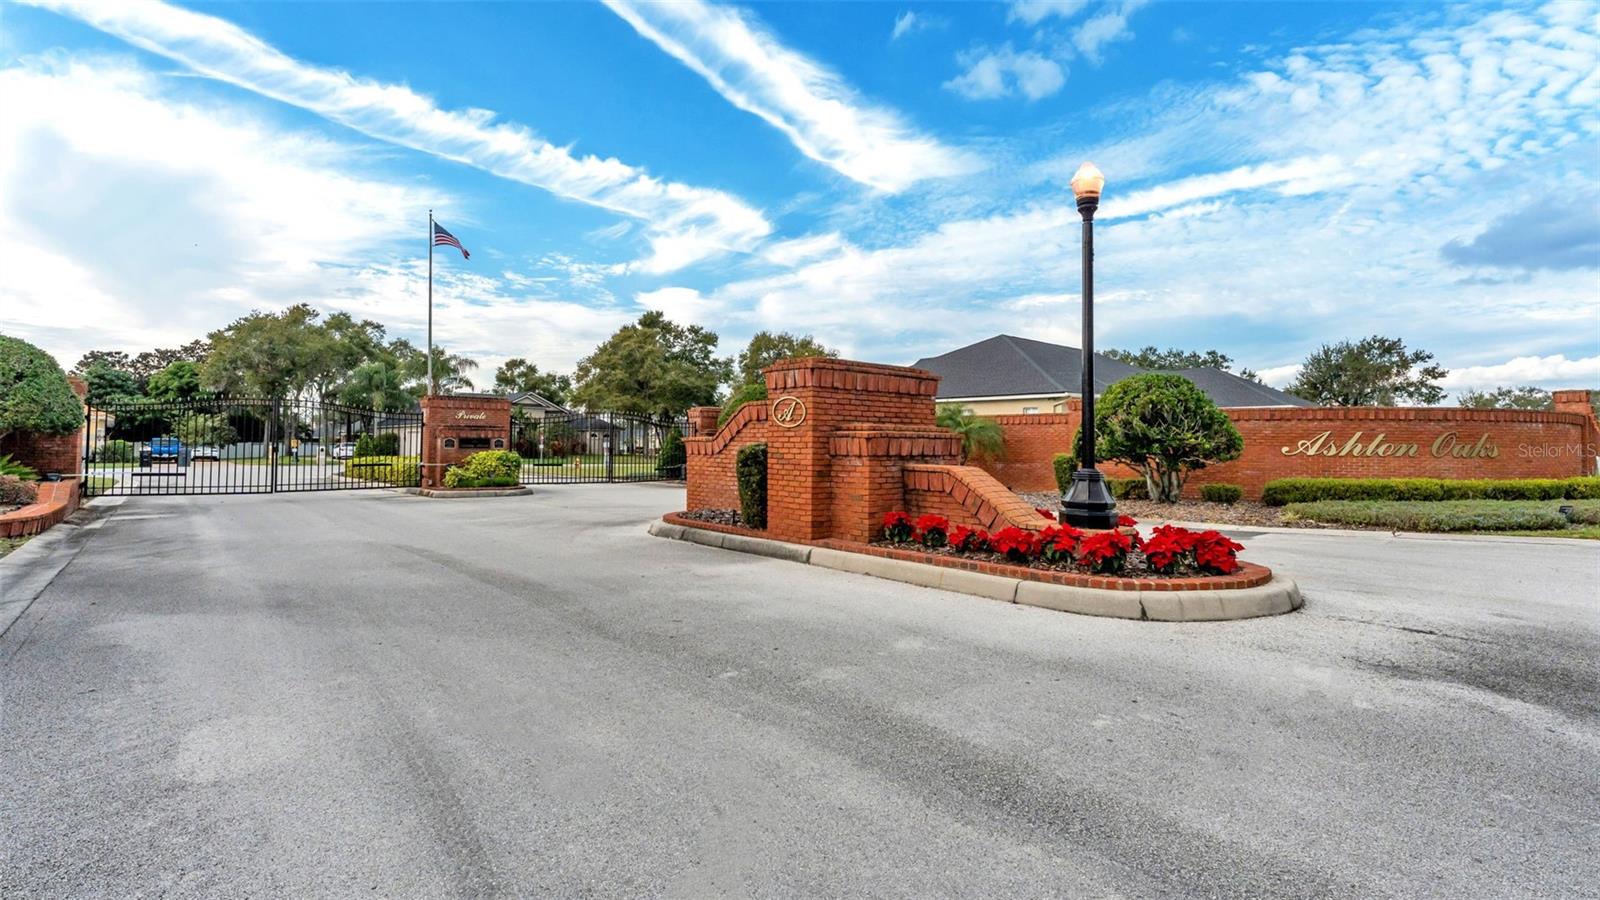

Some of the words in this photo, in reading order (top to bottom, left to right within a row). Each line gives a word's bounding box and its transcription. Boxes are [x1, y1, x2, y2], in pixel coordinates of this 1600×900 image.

[455, 410, 487, 420] Private
[778, 401, 797, 421] A
[1281, 430, 1418, 457] Ashton
[1431, 431, 1499, 458] Oaks
